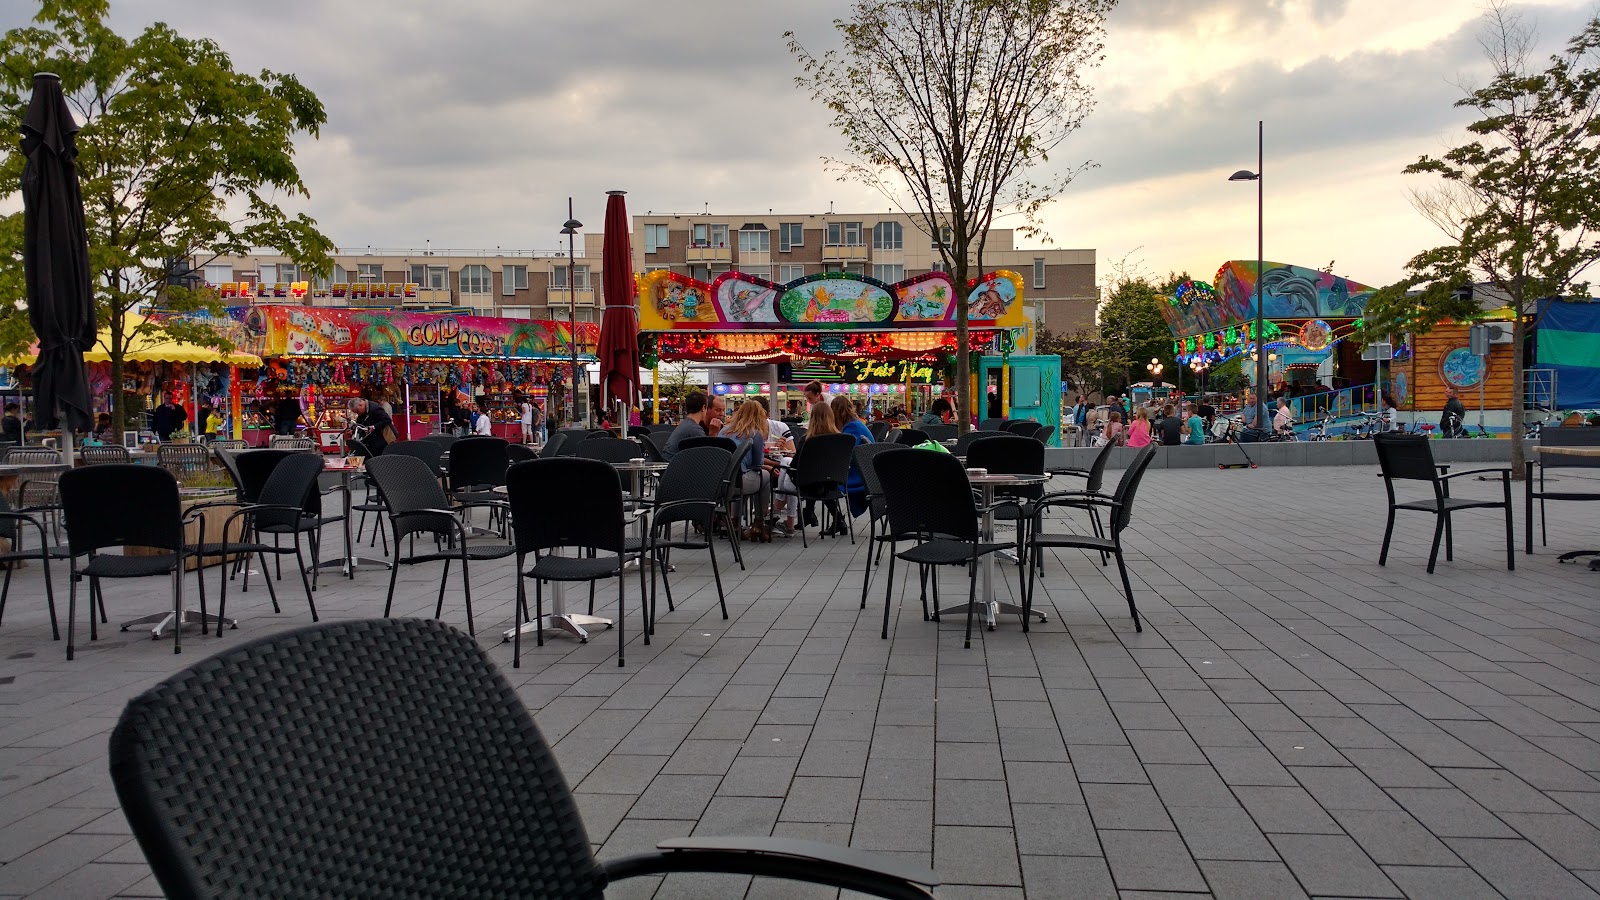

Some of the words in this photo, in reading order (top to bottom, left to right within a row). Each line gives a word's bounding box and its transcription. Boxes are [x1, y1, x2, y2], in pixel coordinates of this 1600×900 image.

[220, 281, 309, 299] ALLEY
[406, 317, 460, 346] GOLD
[457, 327, 505, 356] COAST
[853, 357, 895, 381] Fair
